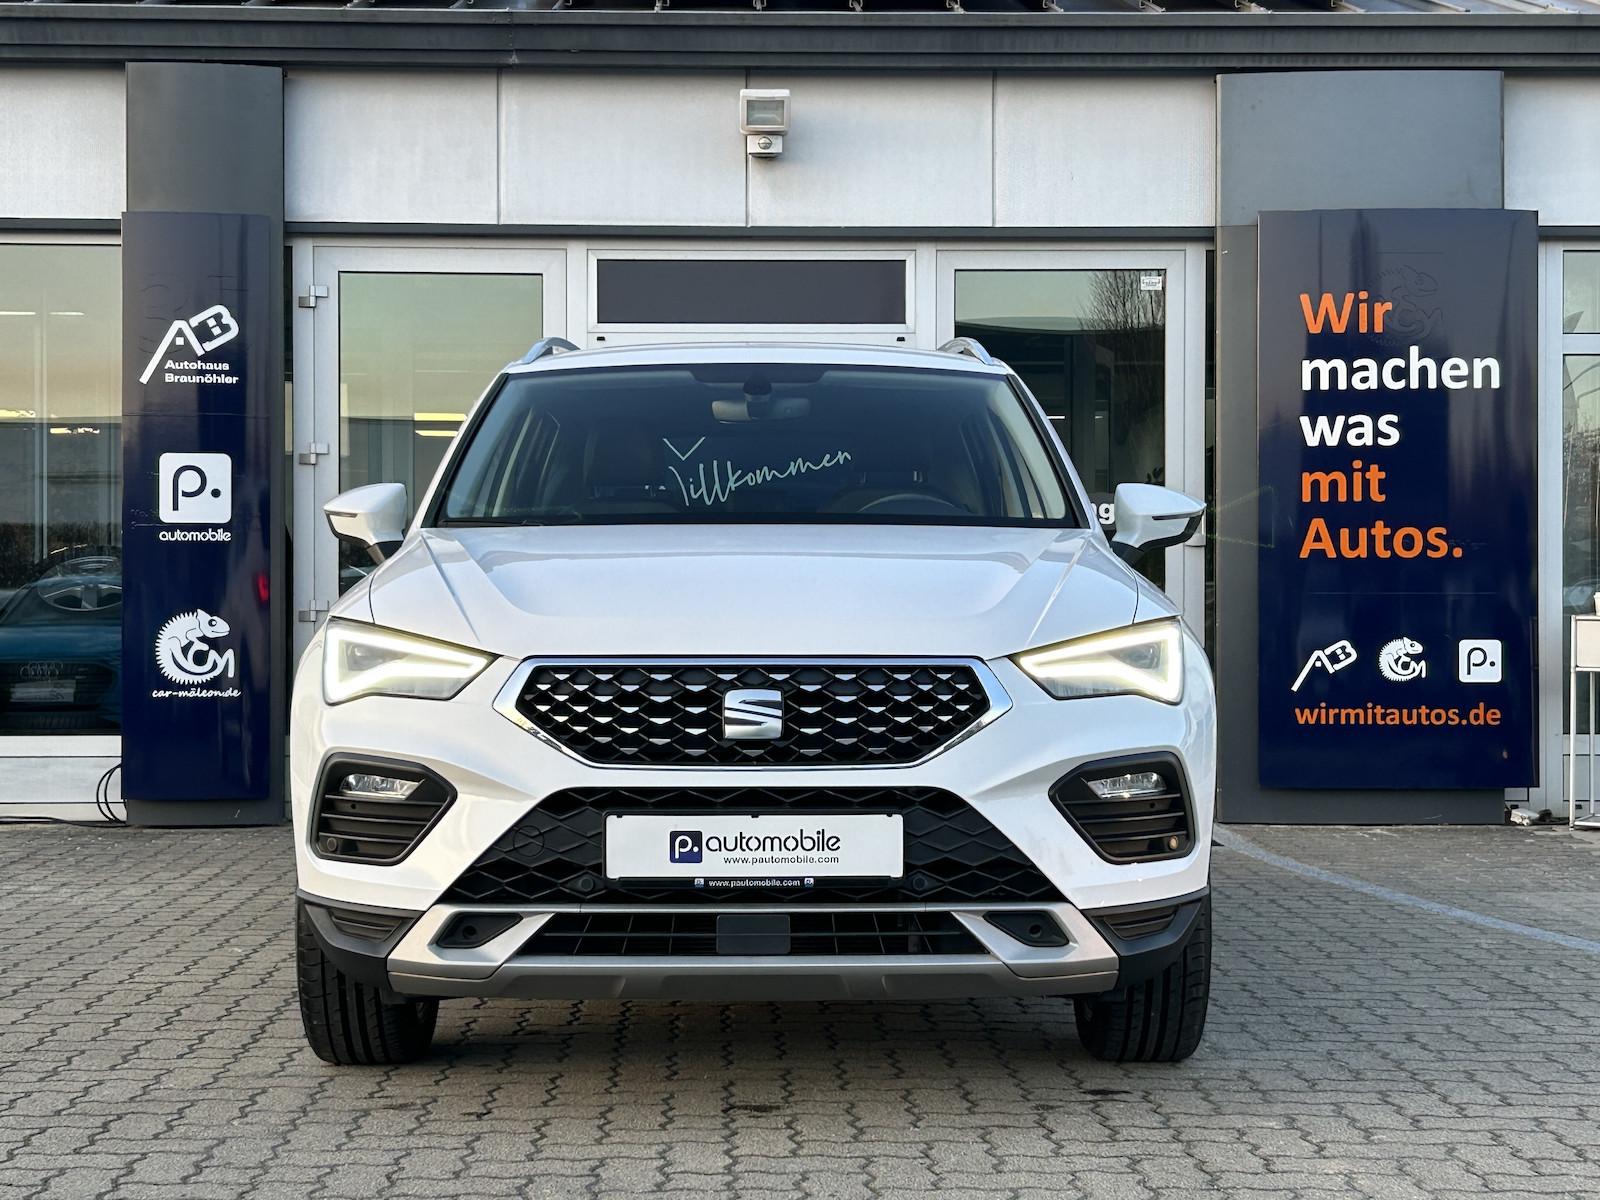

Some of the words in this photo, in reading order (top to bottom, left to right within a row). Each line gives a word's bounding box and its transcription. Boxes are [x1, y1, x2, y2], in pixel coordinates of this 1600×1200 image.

[1299, 290, 1392, 334] Wir
[164, 359, 230, 371] Autohaus
[1301, 345, 1501, 391] machen
[164, 372, 239, 384] Braunöhler
[1299, 413, 1400, 447] was
[1301, 459, 1386, 503] mit
[158, 528, 232, 541] automobile
[1299, 517, 1463, 559] Autos.
[1294, 702, 1502, 726] wirmitautos.de
[705, 828, 842, 852] automobile
[723, 855, 840, 866] www.pautomobile.com
[708, 878, 801, 888] www.pautomobile.com
